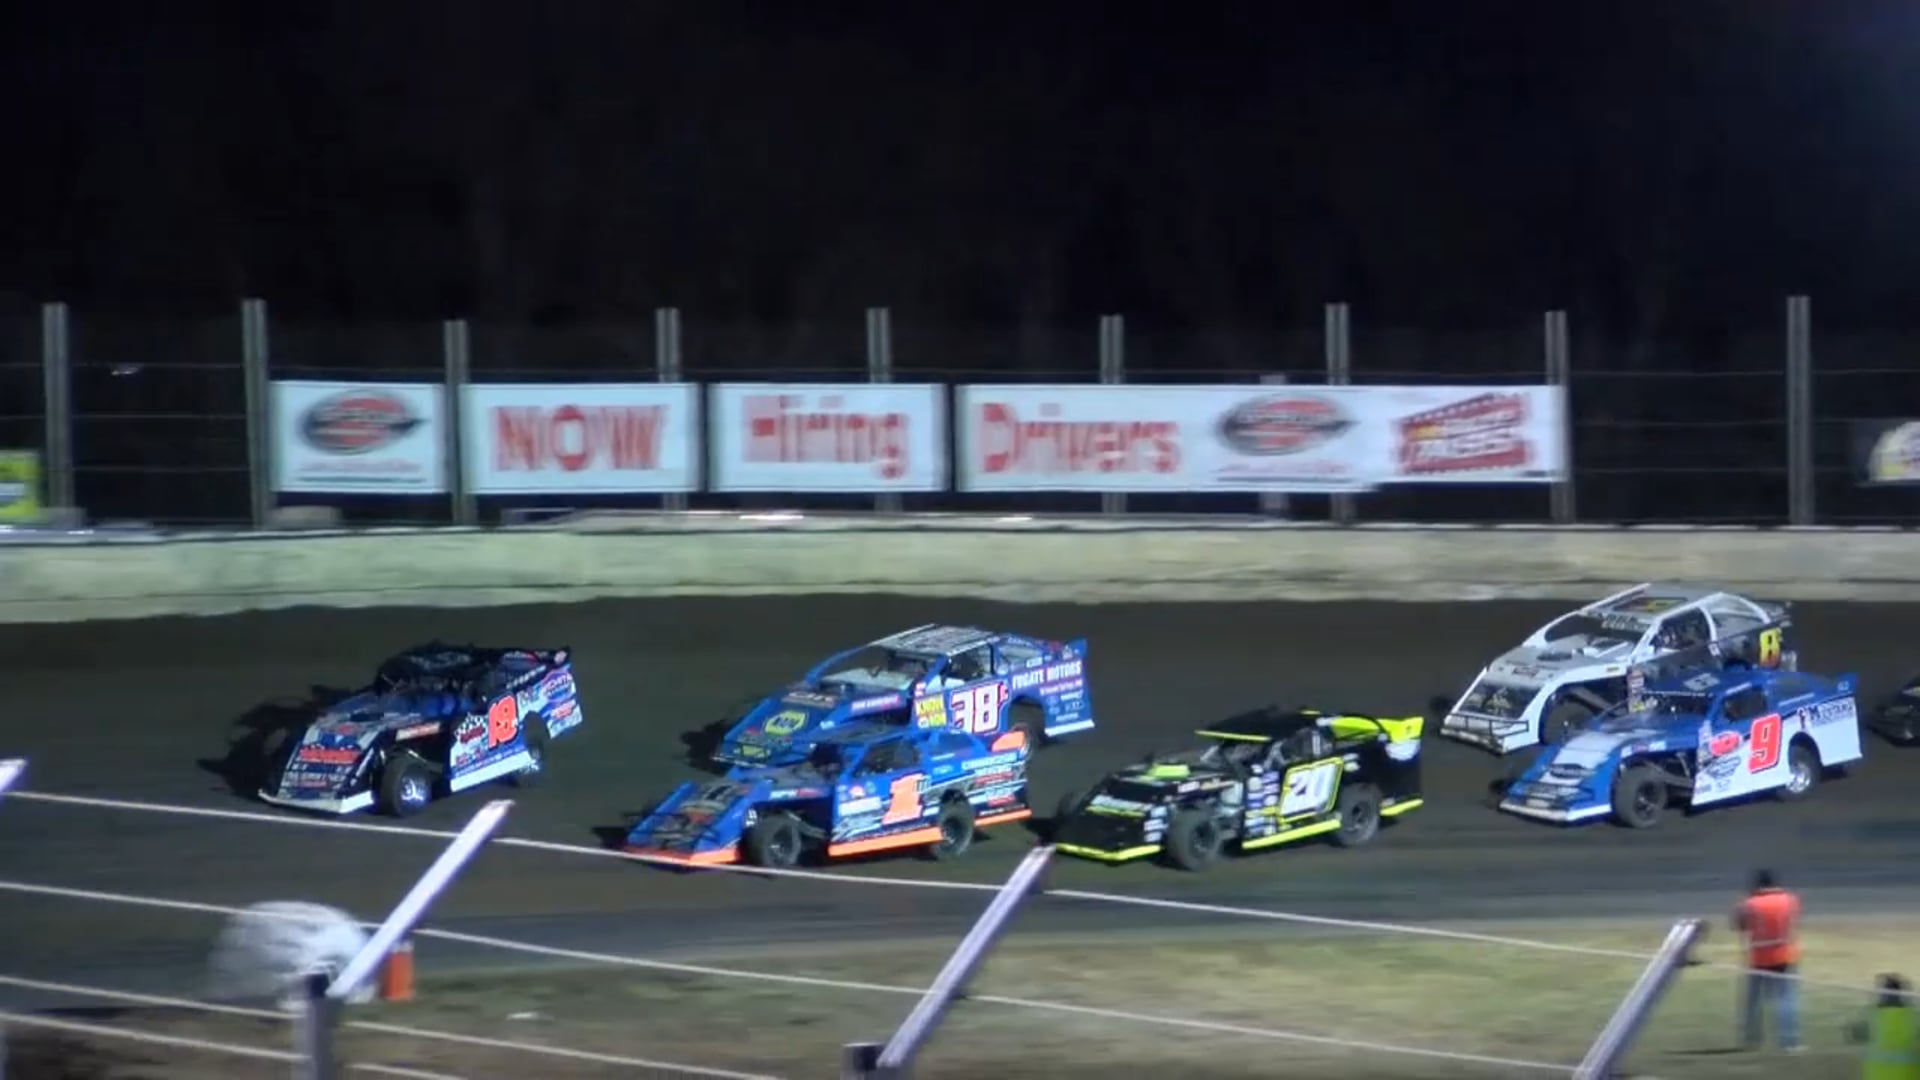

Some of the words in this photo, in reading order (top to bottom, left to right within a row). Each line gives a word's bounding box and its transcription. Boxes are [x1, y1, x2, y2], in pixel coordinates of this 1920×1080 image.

[493, 403, 664, 472] NOW
[743, 395, 908, 478] Hiring
[980, 402, 1177, 473] Drivers
[1747, 713, 1781, 774] 9
